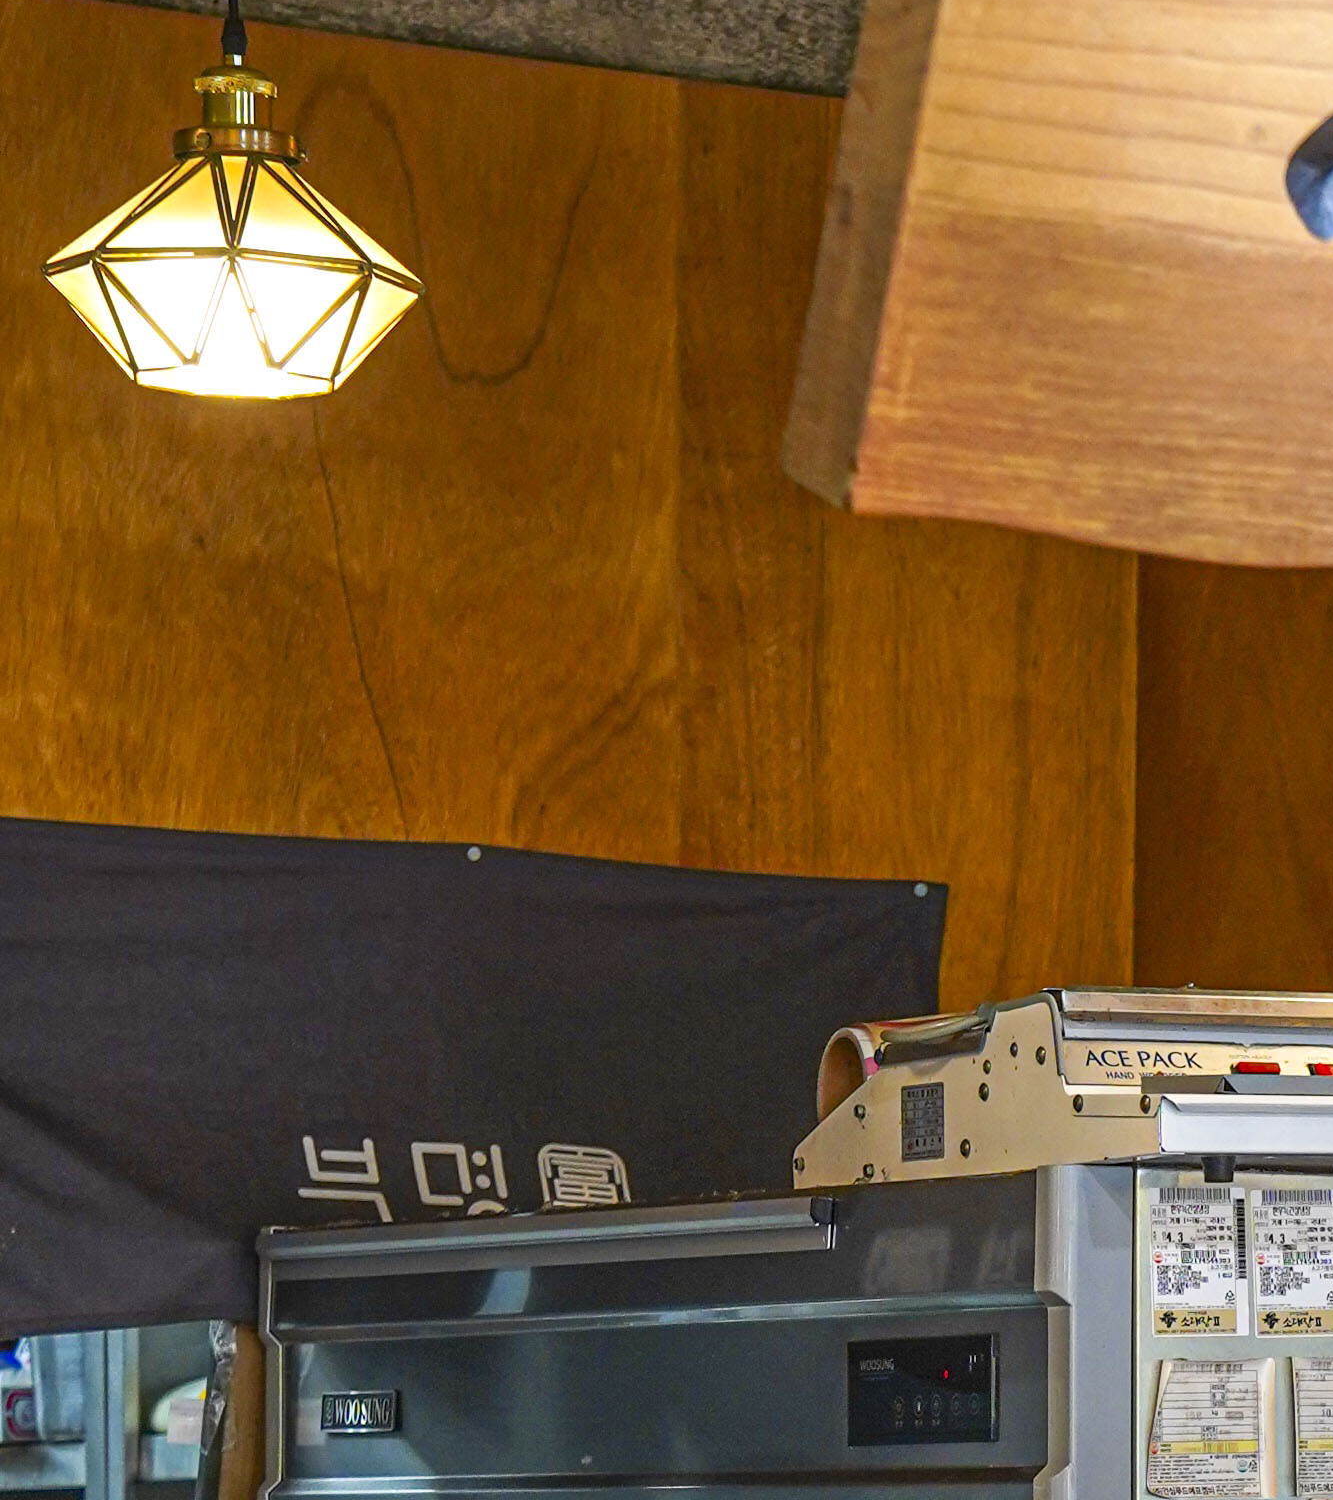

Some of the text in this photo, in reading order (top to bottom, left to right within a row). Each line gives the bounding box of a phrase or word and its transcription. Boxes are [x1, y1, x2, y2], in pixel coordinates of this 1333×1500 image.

[1085, 1050, 1203, 1069] ACE PACK
[1106, 1071, 1135, 1080] HAND
